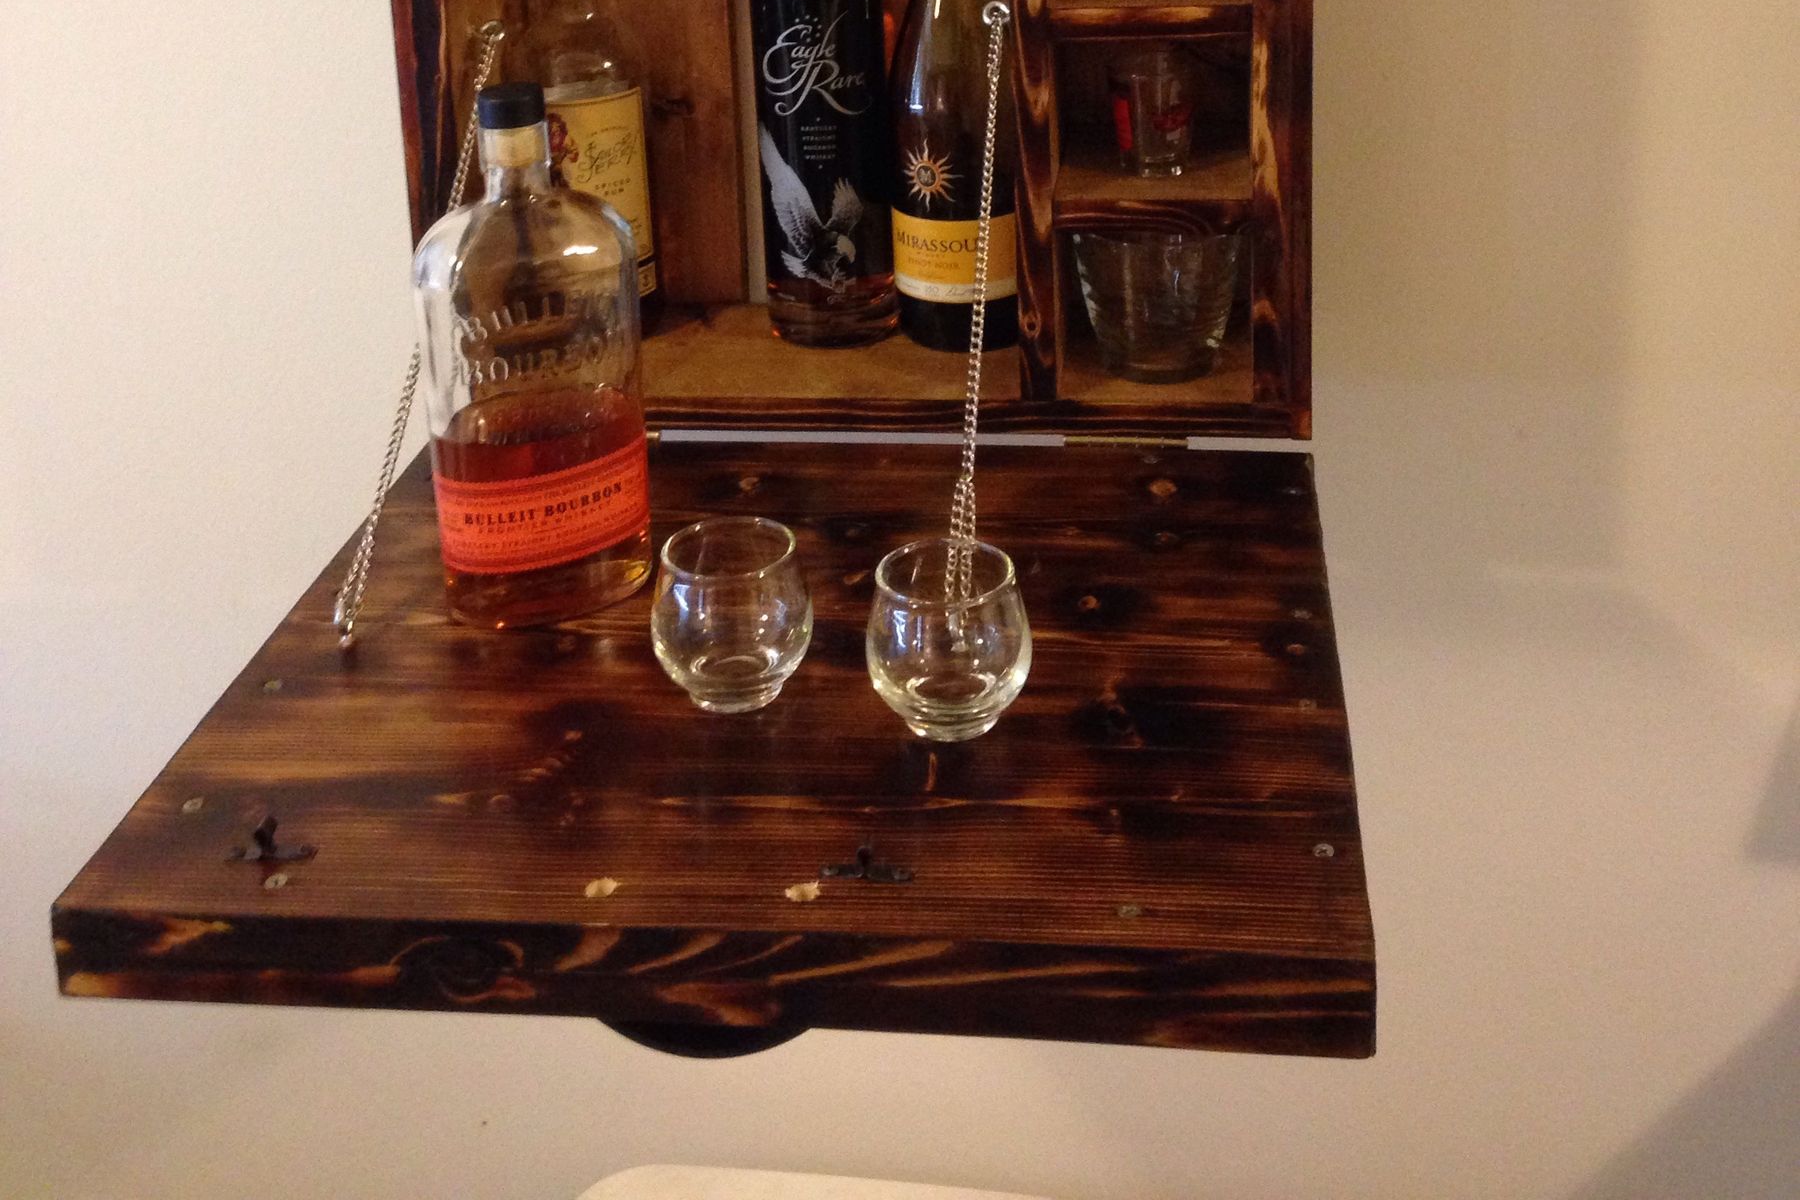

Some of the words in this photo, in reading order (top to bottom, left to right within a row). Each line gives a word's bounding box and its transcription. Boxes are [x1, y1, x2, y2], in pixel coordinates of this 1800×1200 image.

[762, 10, 849, 96] Eagle
[774, 59, 874, 116] Rare
[896, 230, 979, 254] MIRASSOU
[464, 508, 536, 526] BULLEIT
[544, 482, 622, 517] BOURBON
